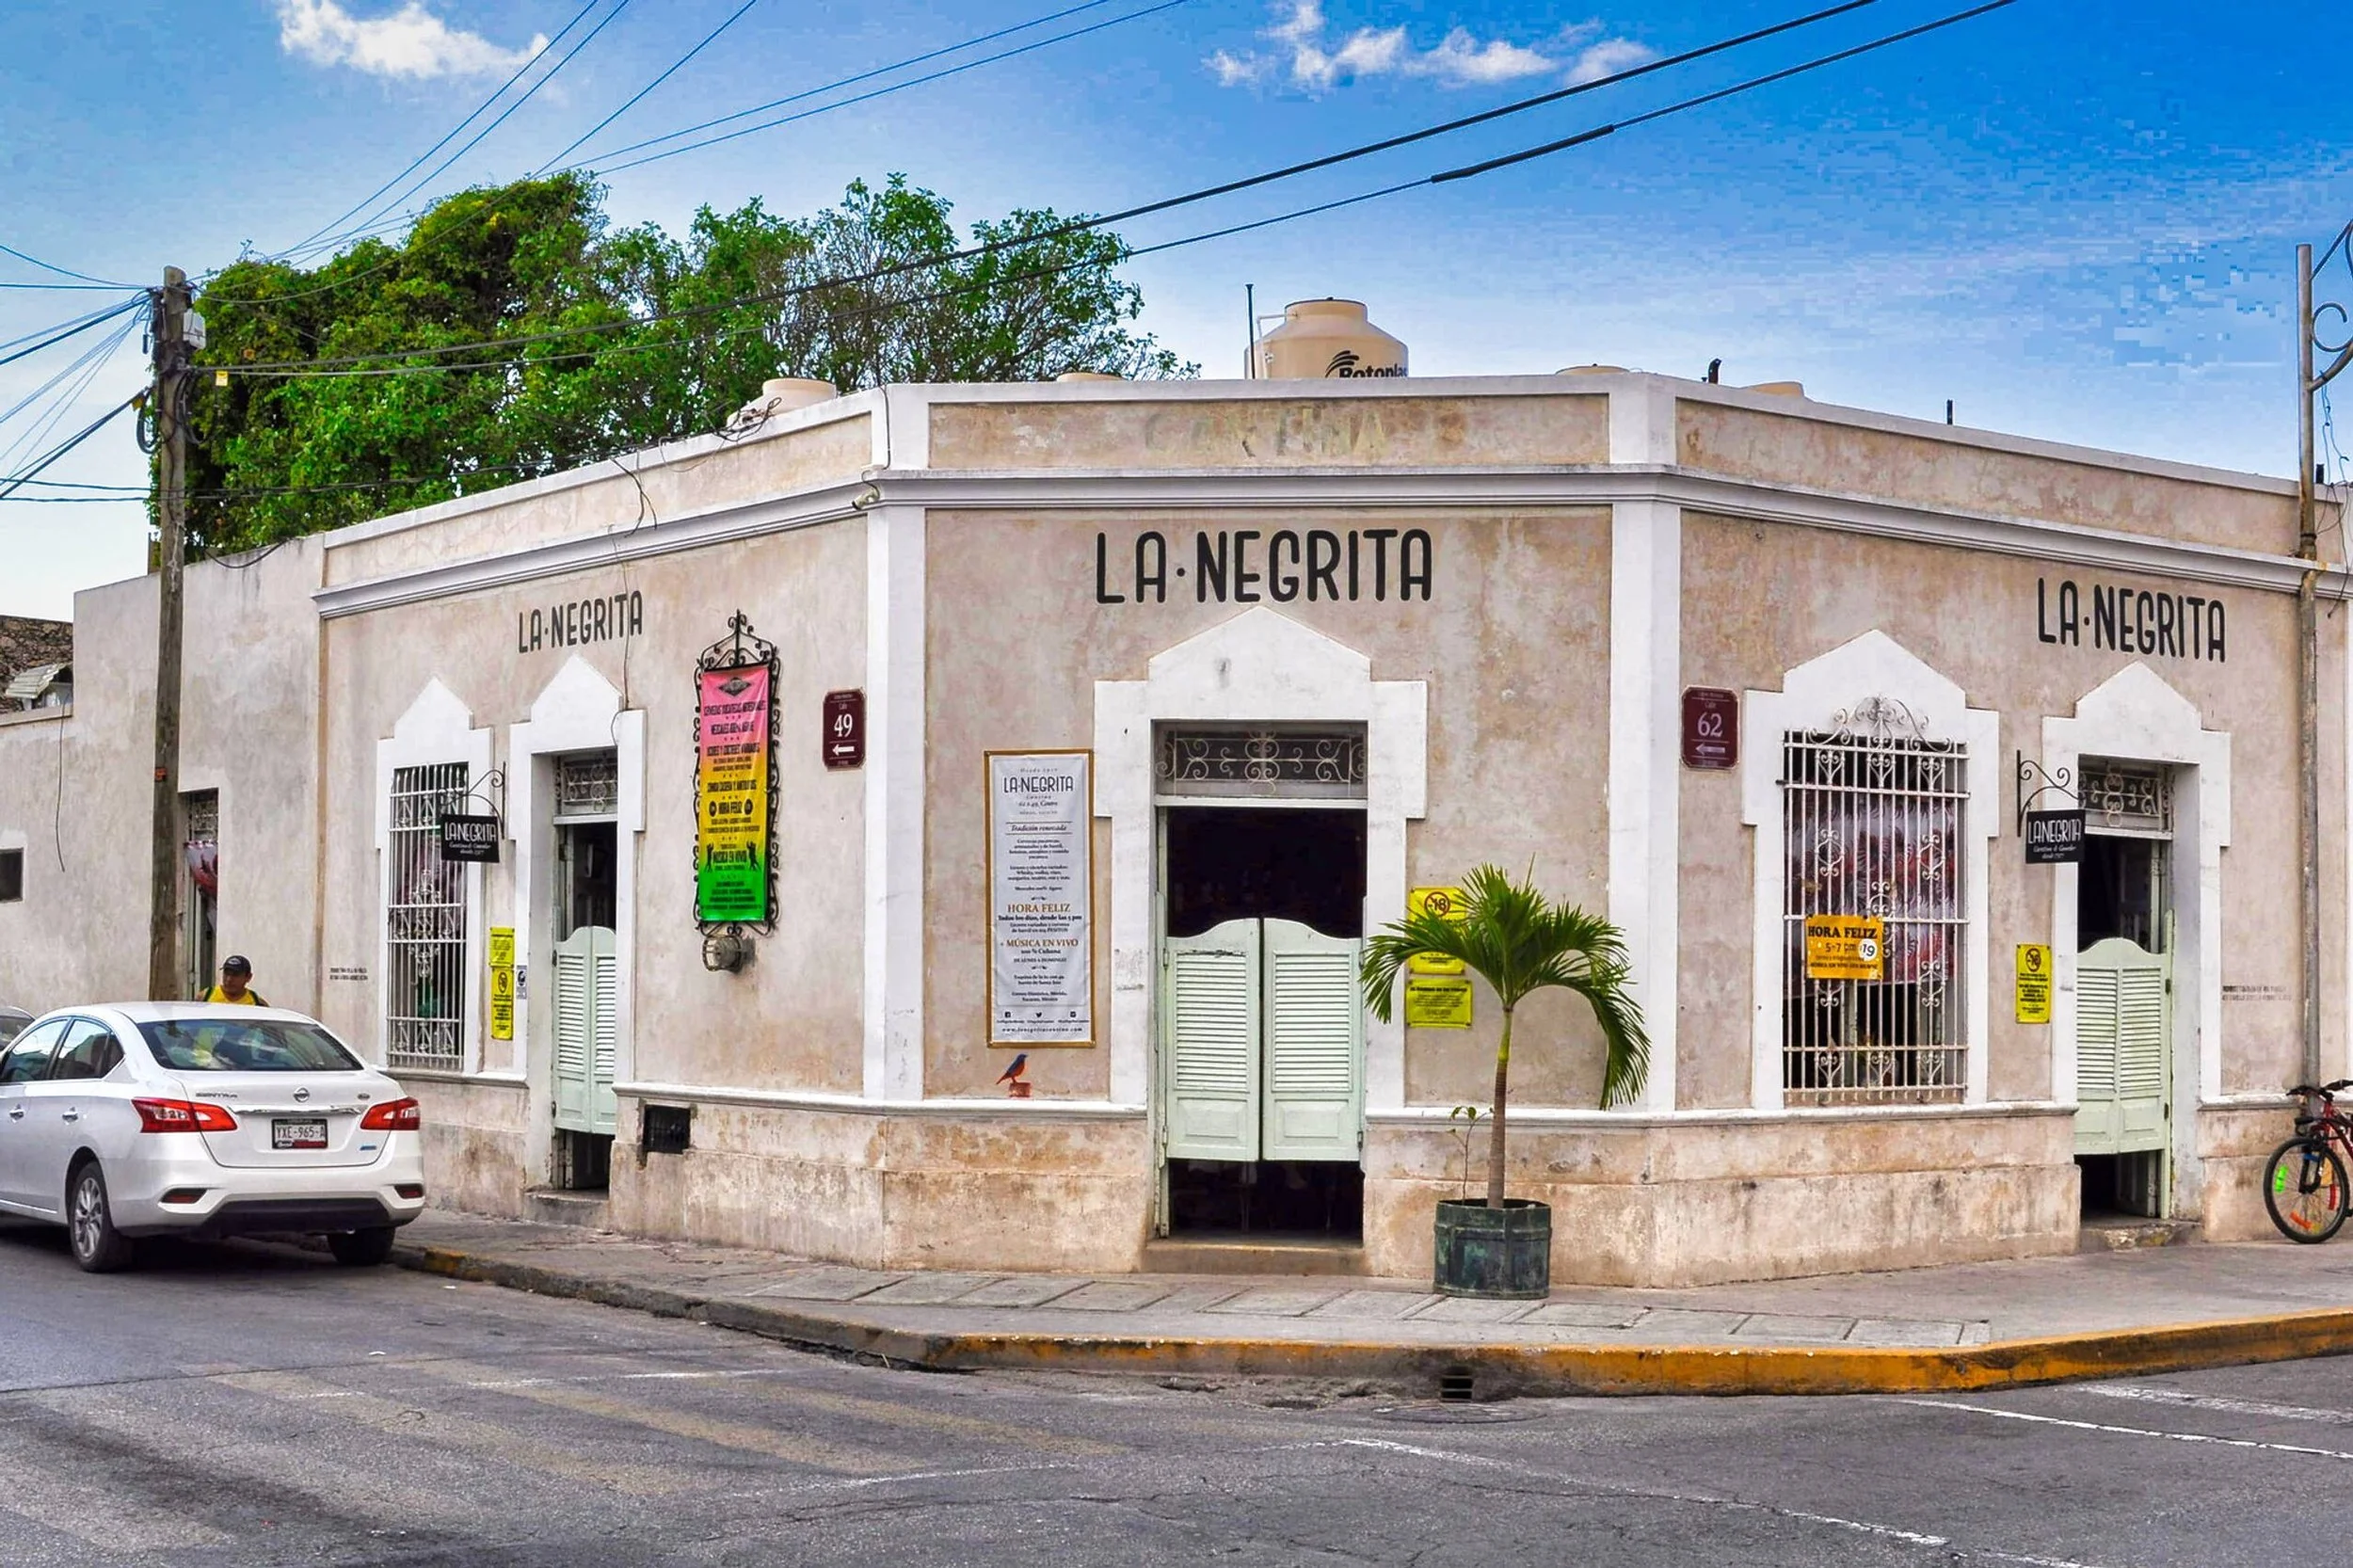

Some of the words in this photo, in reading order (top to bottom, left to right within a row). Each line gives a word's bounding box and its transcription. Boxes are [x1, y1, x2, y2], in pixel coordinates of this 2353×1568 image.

[834, 713, 853, 737] 49
[1697, 712, 1723, 737] 62
[1008, 904, 1038, 913] HORA
[1042, 904, 1070, 913] FELIZ
[1808, 926, 1840, 937] HORA
[1844, 927, 1877, 938] FELIZ
